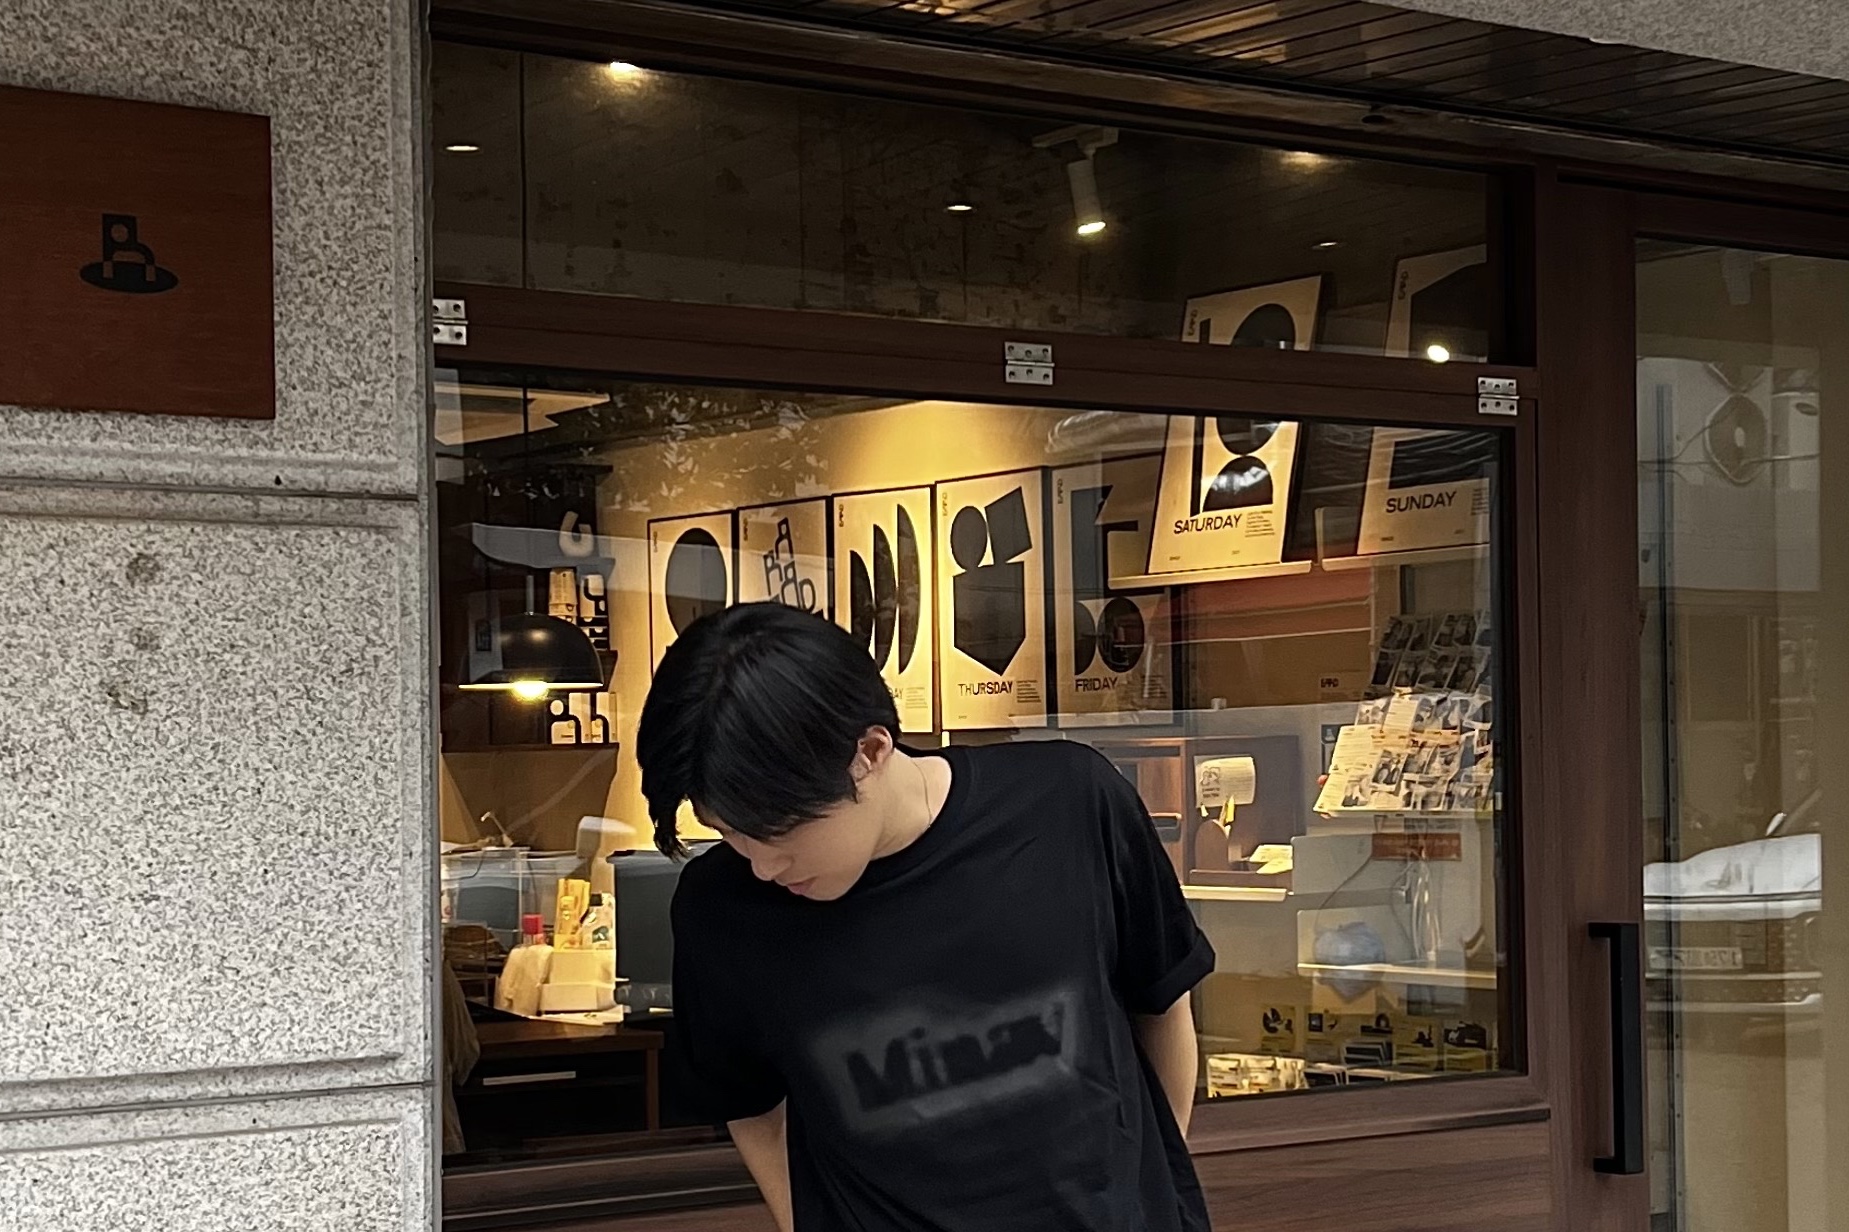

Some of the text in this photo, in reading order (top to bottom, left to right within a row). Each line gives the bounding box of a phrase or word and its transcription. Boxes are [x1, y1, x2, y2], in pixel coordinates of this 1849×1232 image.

[1386, 491, 1457, 514] SUNDAY
[1173, 513, 1243, 535] SATURDAY
[957, 680, 1014, 697] THURSDAY
[1075, 677, 1118, 693] FRIDAY
